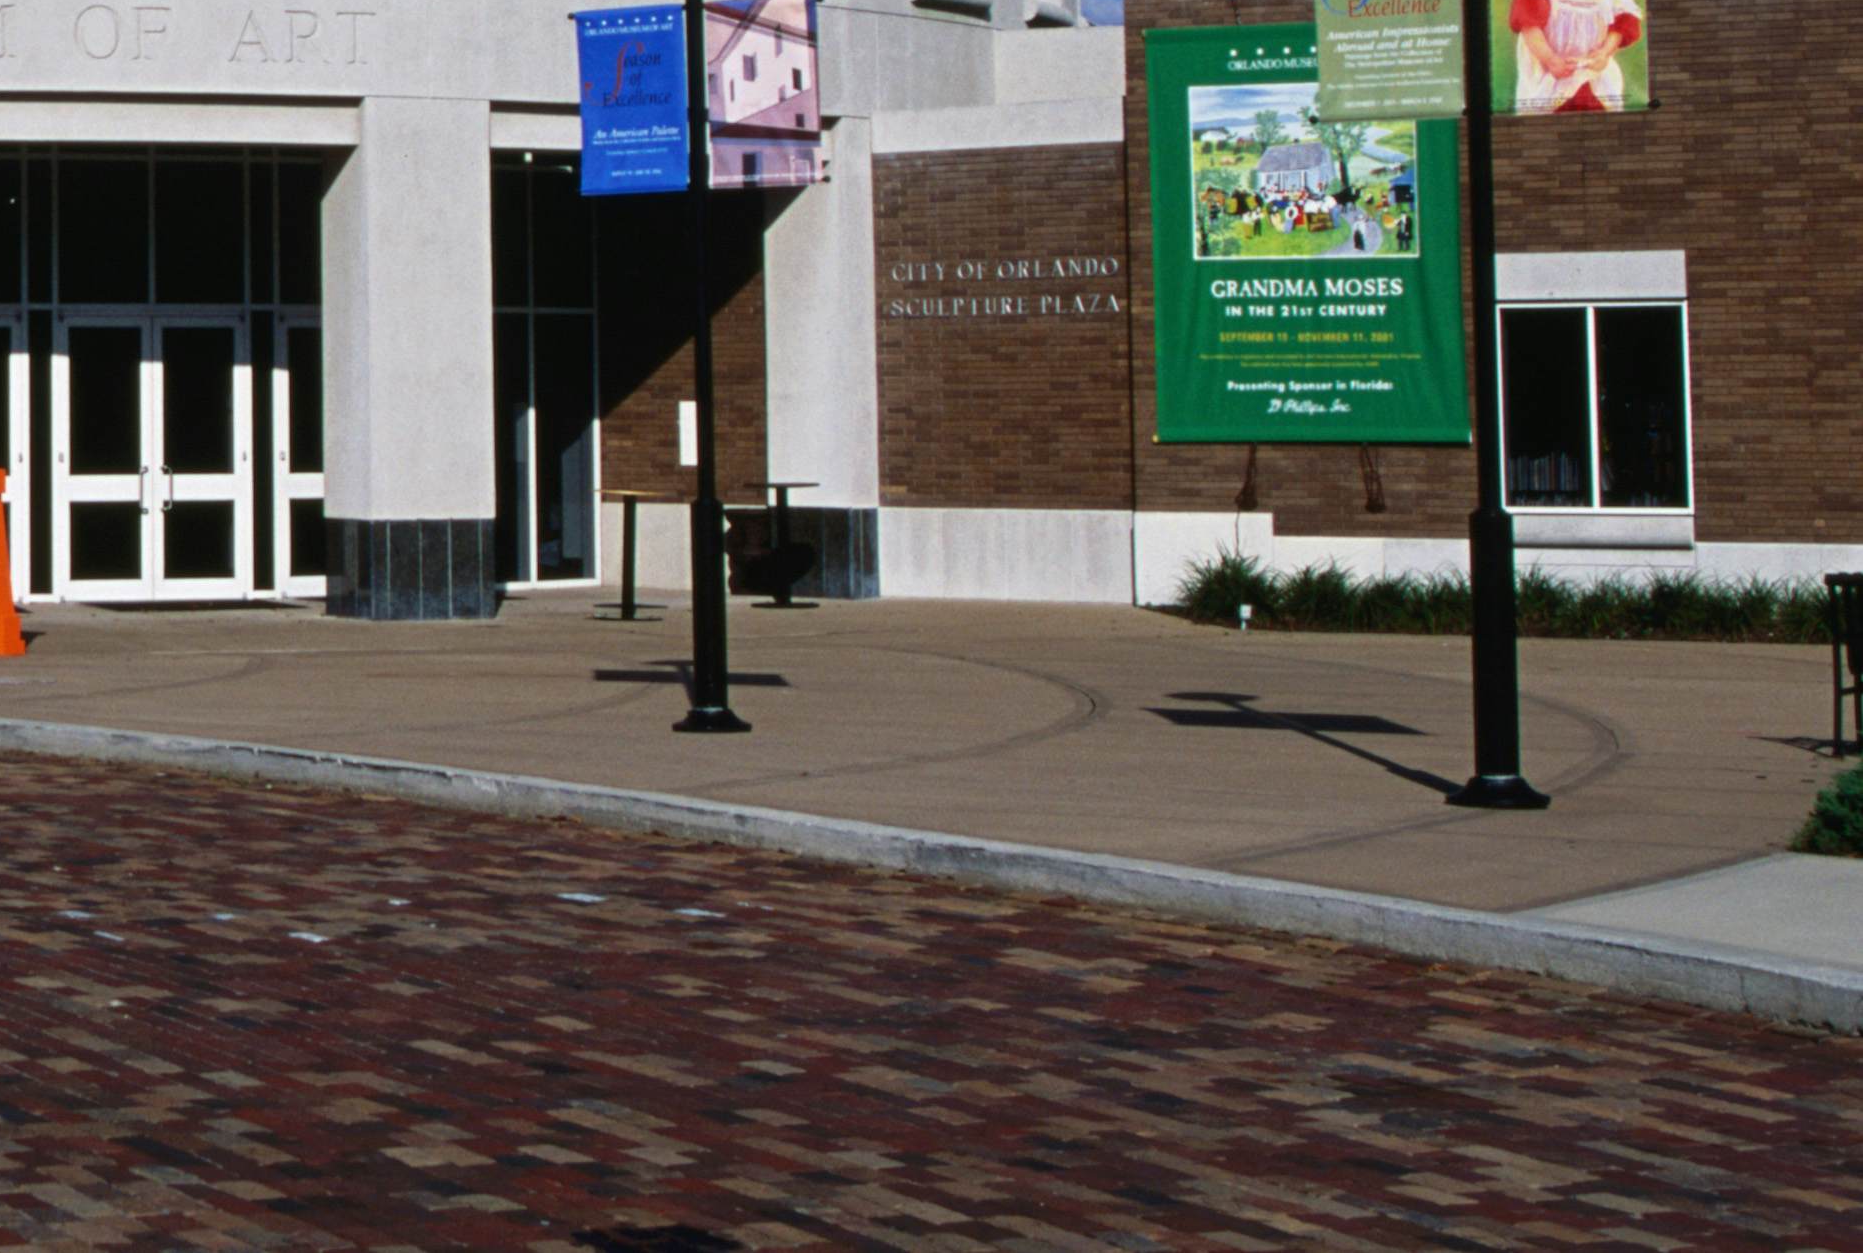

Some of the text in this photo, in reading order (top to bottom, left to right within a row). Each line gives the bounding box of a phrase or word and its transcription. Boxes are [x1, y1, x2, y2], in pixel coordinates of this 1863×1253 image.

[72, 3, 172, 61] OF
[228, 9, 377, 66] ART
[1227, 58, 1283, 71] ORLANDO
[891, 256, 1119, 282] CITY OF ORLANDO
[1210, 277, 1404, 298] GRANDMA MOSES
[890, 293, 1120, 317] SCULPTURE PLAZA
[1225, 305, 1242, 317] IN
[1248, 305, 1274, 317] THE
[1318, 304, 1387, 317] CENTURY
[1219, 332, 1274, 344] SEPTEMBER
[1298, 331, 1350, 343] NOVEMBER
[1370, 331, 1394, 343] 2001
[1226, 380, 1285, 394] Presenting
[1288, 380, 1333, 392] Sponsor
[1335, 379, 1347, 391] in
